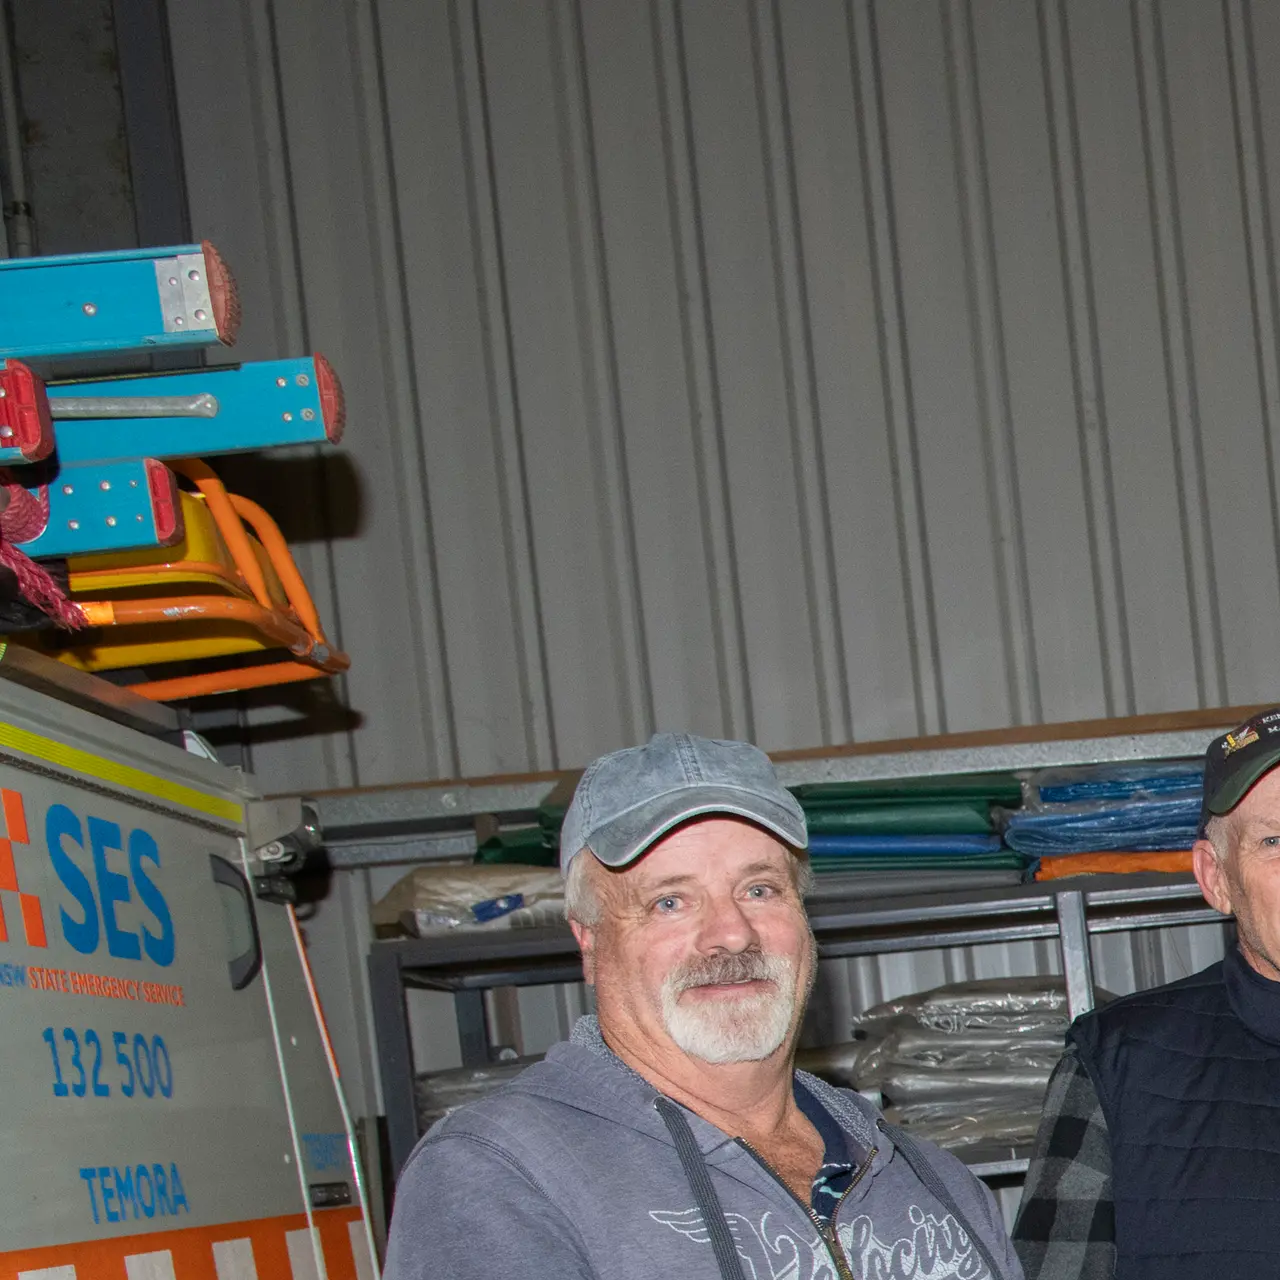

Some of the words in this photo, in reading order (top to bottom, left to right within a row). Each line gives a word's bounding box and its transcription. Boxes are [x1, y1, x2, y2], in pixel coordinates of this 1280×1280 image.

[45, 803, 176, 967] SES
[27, 966, 69, 993] STATE
[69, 971, 142, 1001] EMERGENCY
[142, 979, 186, 1007] SERVICE
[42, 1027, 110, 1097] 132
[112, 1031, 173, 1098] 500
[79, 1161, 191, 1225] TEMORA
